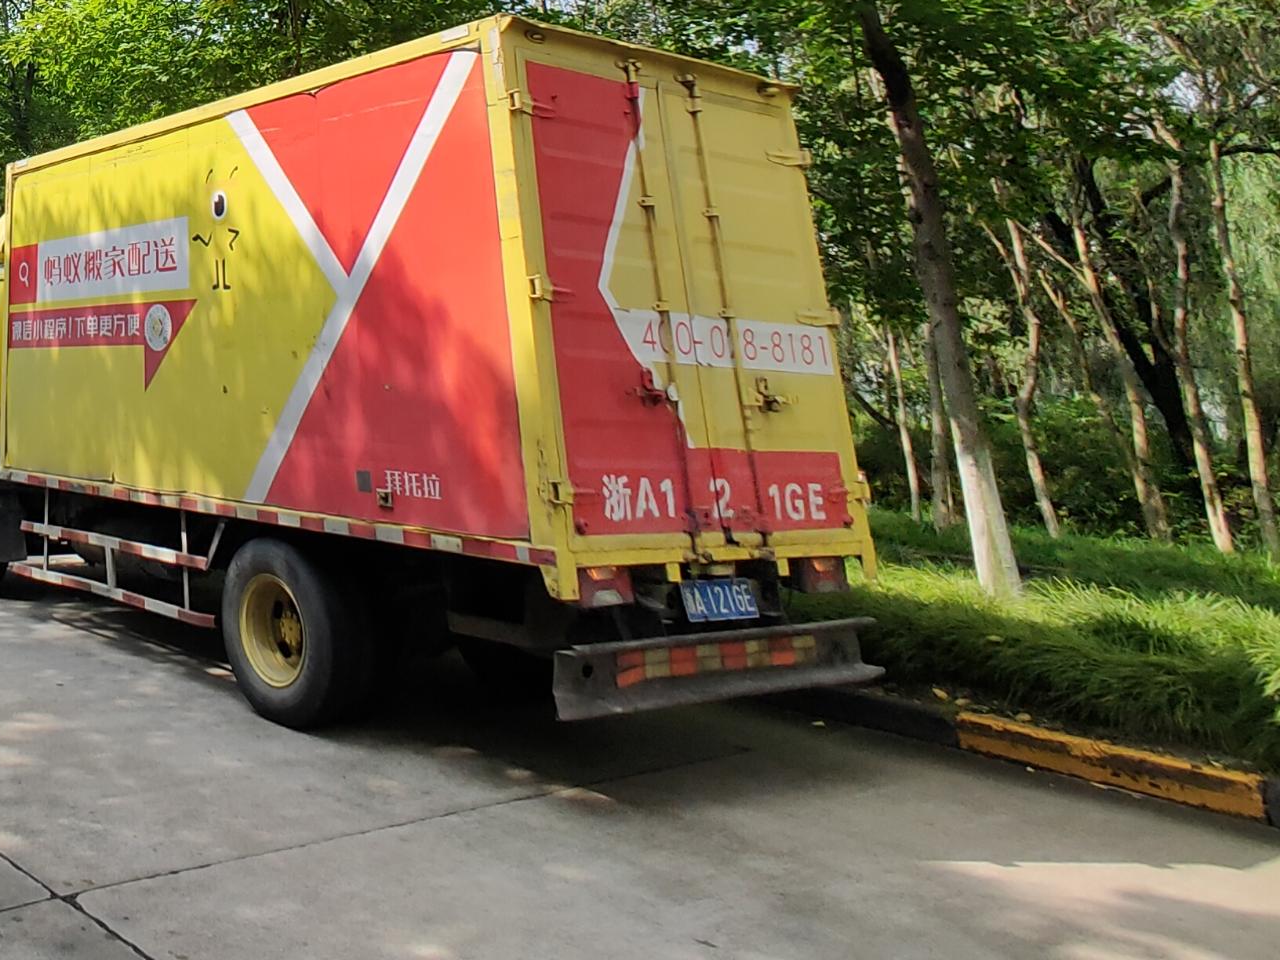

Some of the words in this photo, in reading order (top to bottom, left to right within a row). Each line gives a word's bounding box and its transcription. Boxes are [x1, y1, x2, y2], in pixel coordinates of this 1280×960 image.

[44, 236, 178, 286] 蚂蚁搬家配送
[642, 320, 828, 366] 400-08-8181
[383, 470, 442, 500] 拜托拉
[602, 474, 677, 522] 浙A1
[768, 483, 827, 521] 1GE
